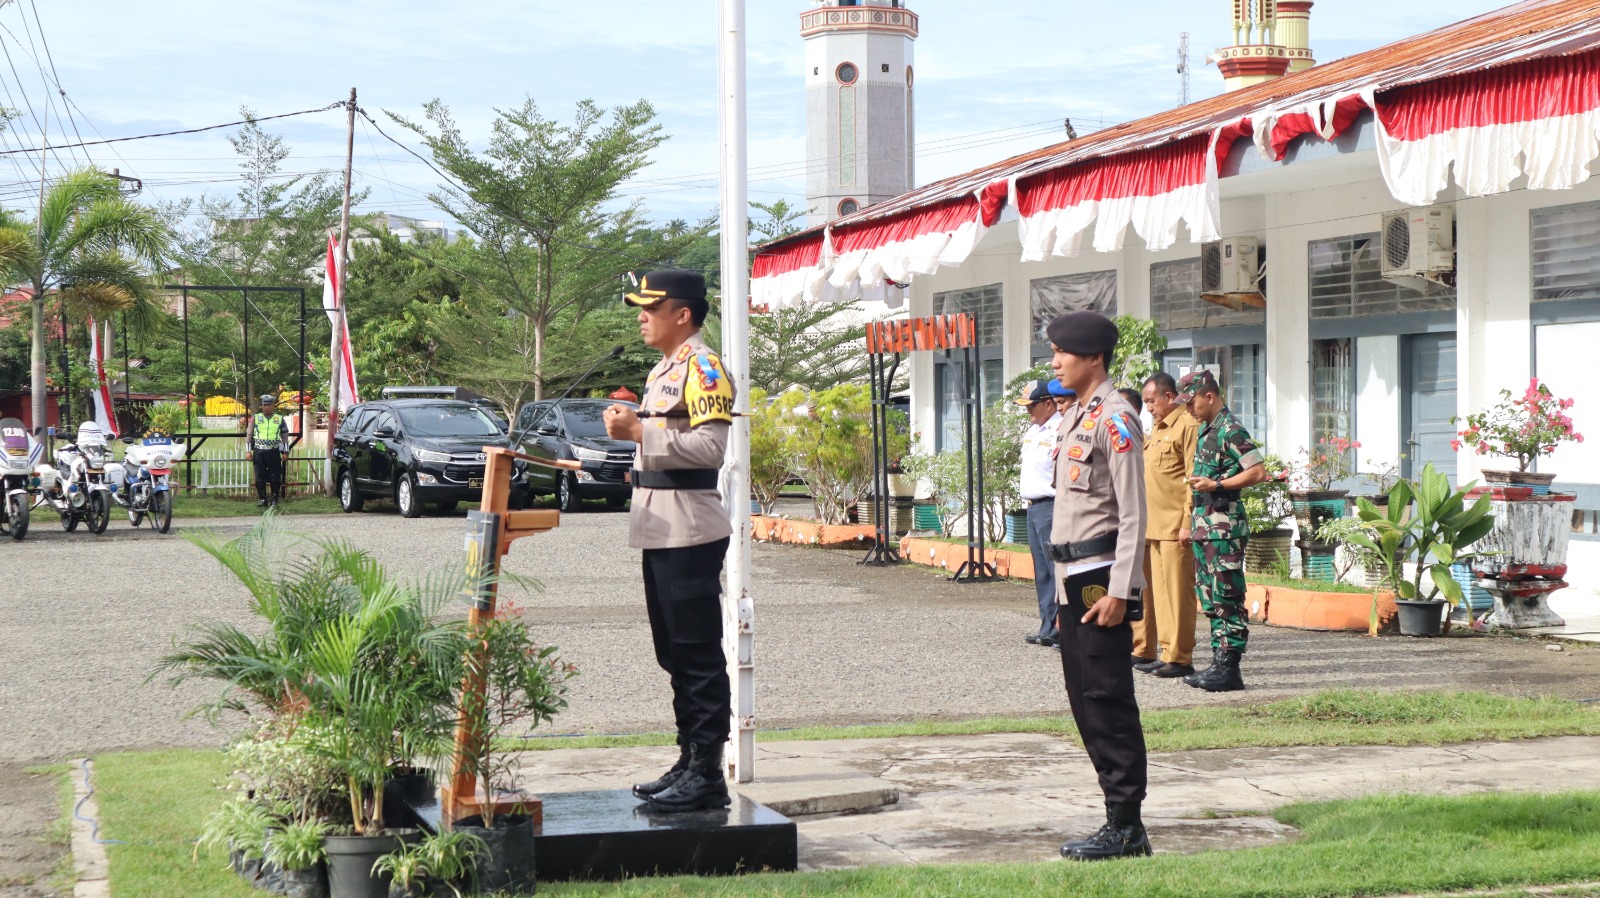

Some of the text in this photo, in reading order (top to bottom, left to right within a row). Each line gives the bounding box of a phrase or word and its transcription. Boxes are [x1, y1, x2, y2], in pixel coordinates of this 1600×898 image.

[661, 385, 678, 397] POLRI
[143, 427, 170, 439] PATROLI
[1075, 434, 1092, 444] POLRI
